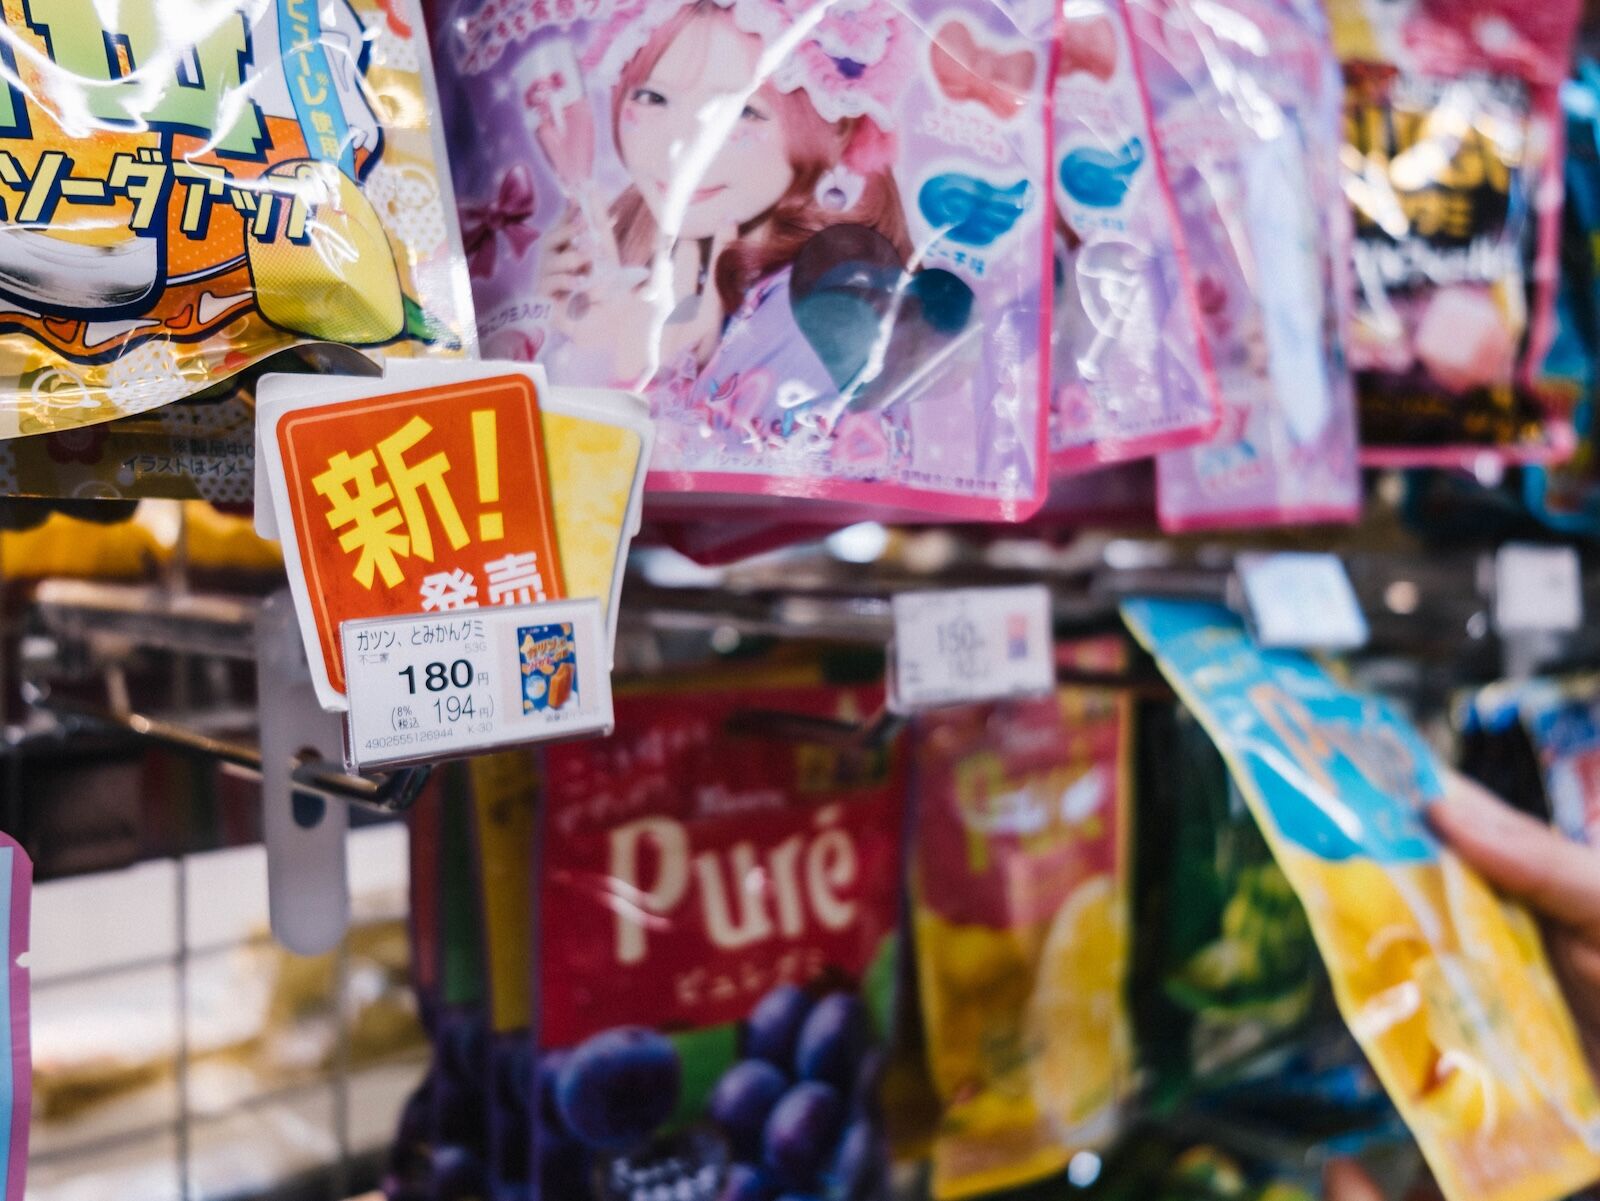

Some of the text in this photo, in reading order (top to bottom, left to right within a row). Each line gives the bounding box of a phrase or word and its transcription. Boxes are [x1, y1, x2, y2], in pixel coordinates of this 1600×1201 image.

[311, 409, 504, 591] 新!
[419, 551, 547, 612] 発売
[365, 728, 454, 750] 4902555126944
[609, 803, 858, 967] Puré
